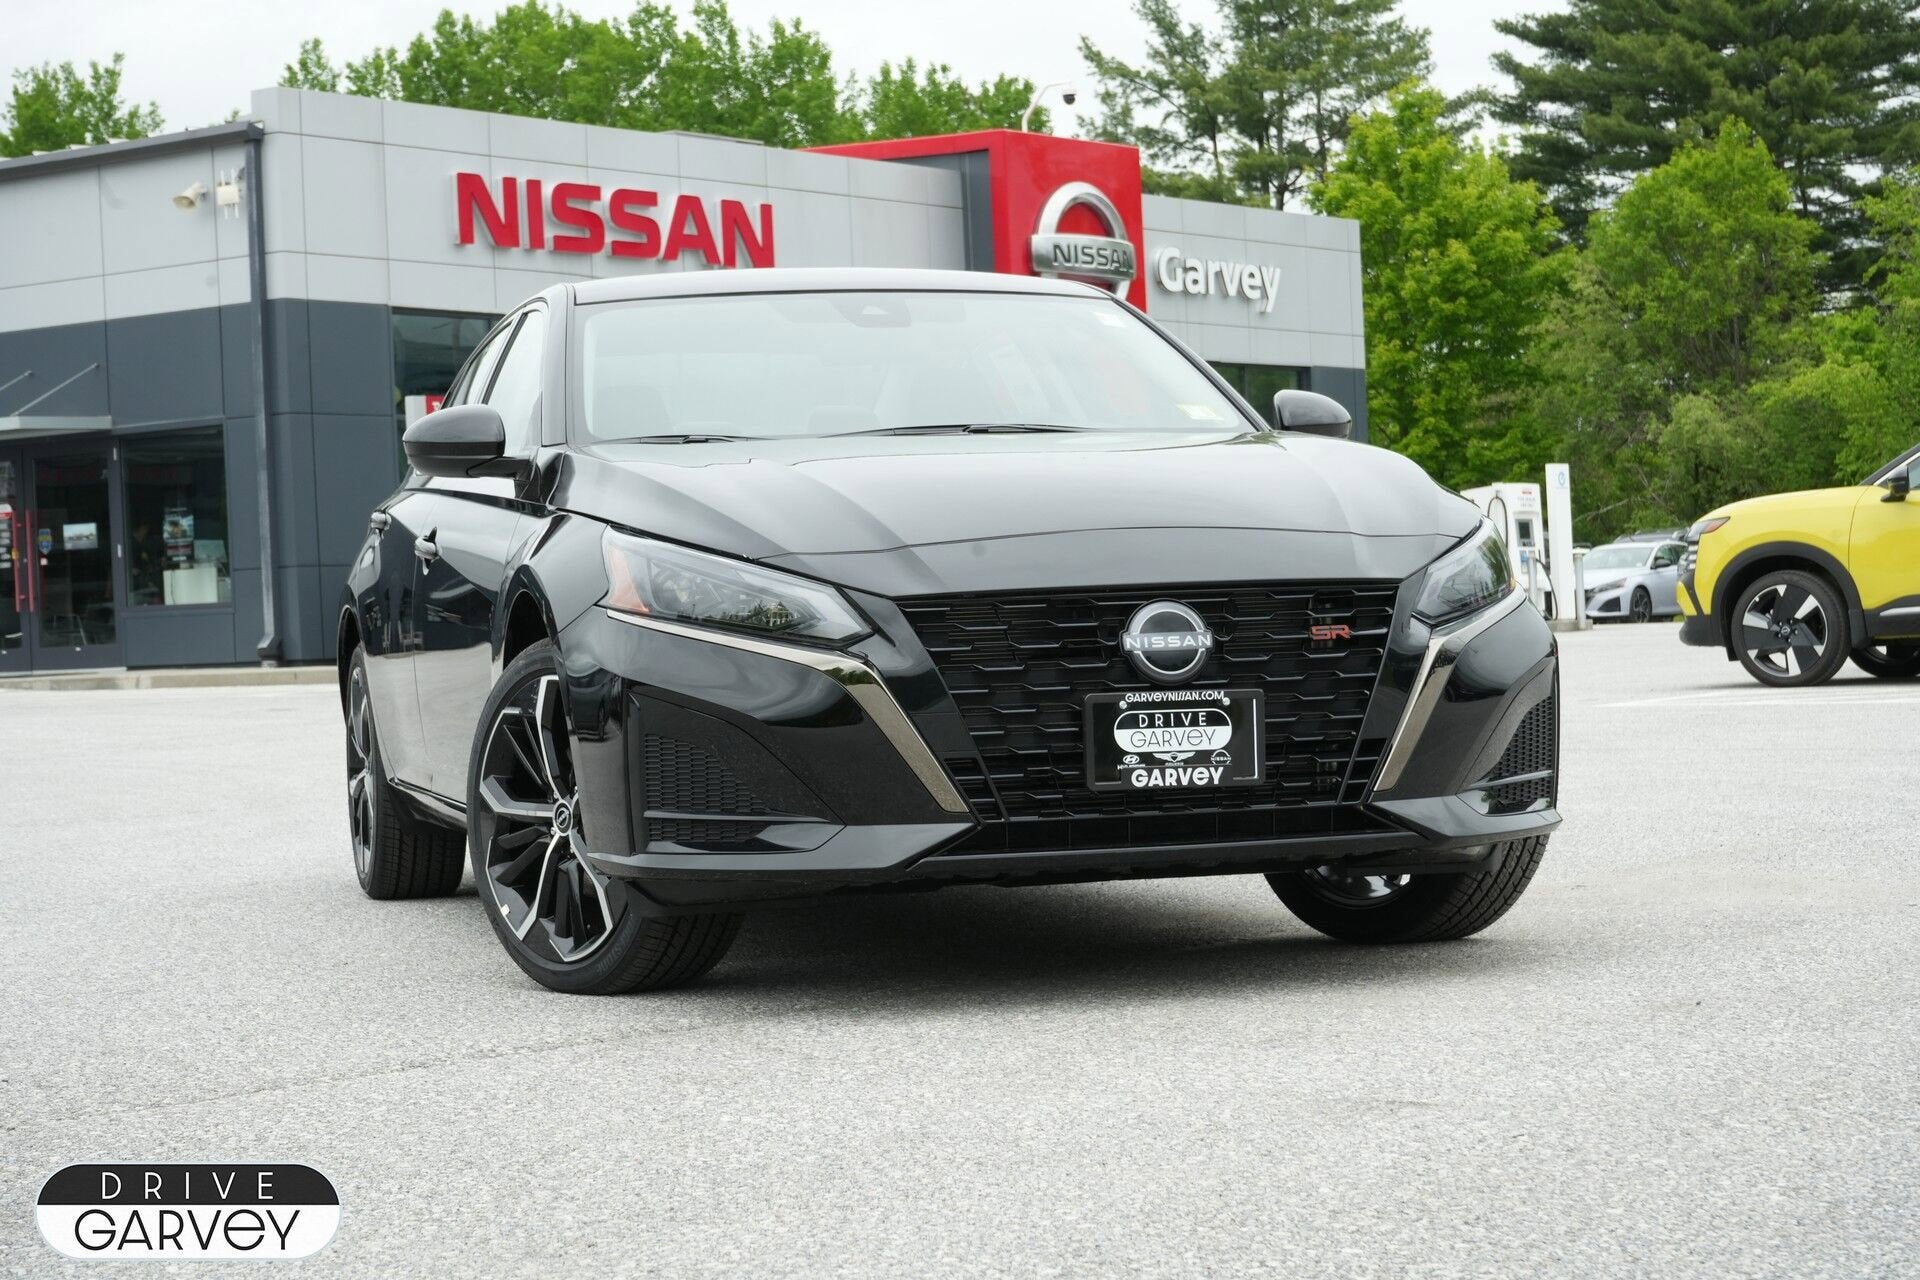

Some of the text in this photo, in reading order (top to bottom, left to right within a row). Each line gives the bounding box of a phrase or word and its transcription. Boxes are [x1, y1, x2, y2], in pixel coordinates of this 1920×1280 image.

[456, 172, 775, 268] NISSAN
[1053, 243, 1133, 271] NISSAN
[1157, 247, 1281, 313] Garvey
[1125, 634, 1212, 649] NISSAN
[1310, 625, 1351, 641] SR
[1138, 712, 1208, 728] DRIVE
